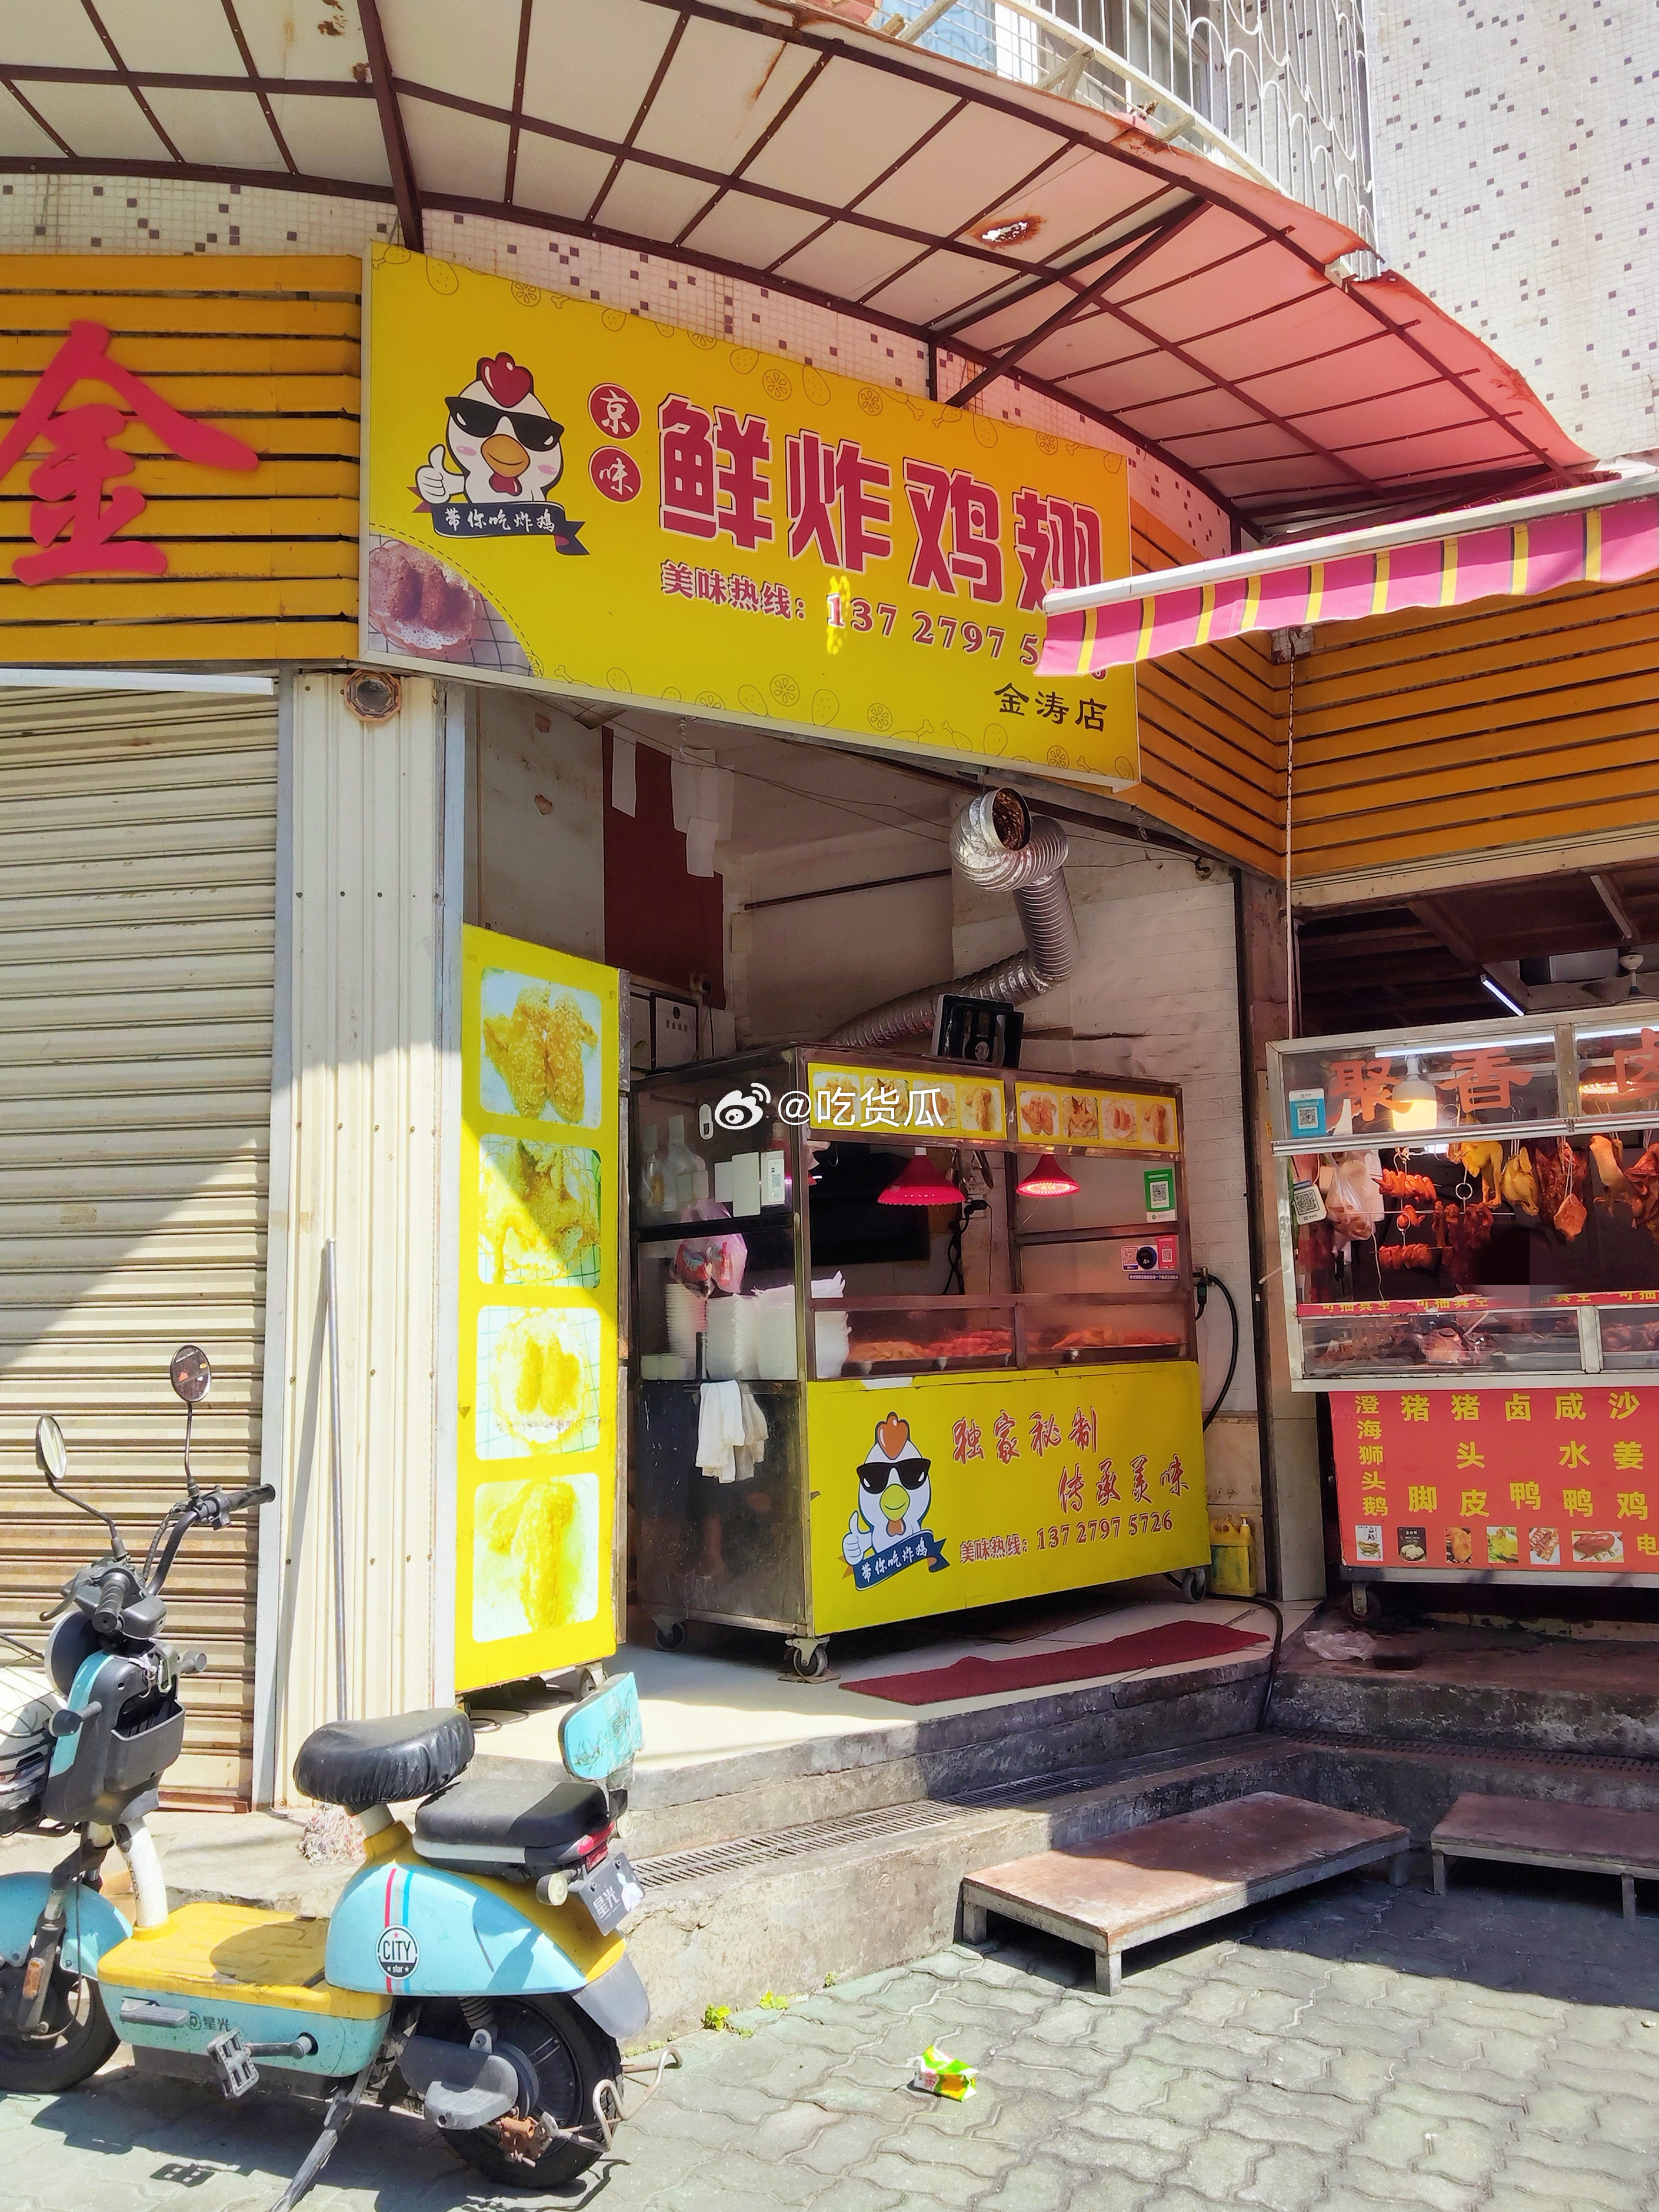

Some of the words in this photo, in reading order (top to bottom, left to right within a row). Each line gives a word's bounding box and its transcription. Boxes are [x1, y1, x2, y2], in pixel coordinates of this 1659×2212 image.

[0, 320, 259, 587] 金
[444, 508, 556, 534] 带你吃炸鸡
[658, 392, 1103, 614] 鲜炸鸡翅
[827, 592, 898, 637] 137
[911, 610, 1006, 659] 2797
[993, 682, 1108, 732] 金涛店
[952, 1405, 1098, 1465] 独家秘制
[1355, 1394, 1388, 1518] 澄海狮头鹅
[1401, 1394, 1438, 1513] 猪脚
[1451, 1393, 1490, 1518] 猪头皮
[1505, 1393, 1541, 1511] 卤鸭
[1555, 1392, 1594, 1518] 咸水鸭
[1607, 1391, 1649, 1521] 沙姜鸡
[1058, 1453, 1190, 1514] 传承美味
[1037, 1525, 1070, 1551] 137
[1077, 1516, 1121, 1544] 2797
[1128, 1510, 1174, 1536] 5726
[861, 1540, 929, 1584] 带你吃炸鸡
[592, 1885, 620, 1920] 星光
[383, 1940, 411, 1961] CITY
[392, 1964, 404, 1973] star
[203, 2016, 234, 2033] 星光
